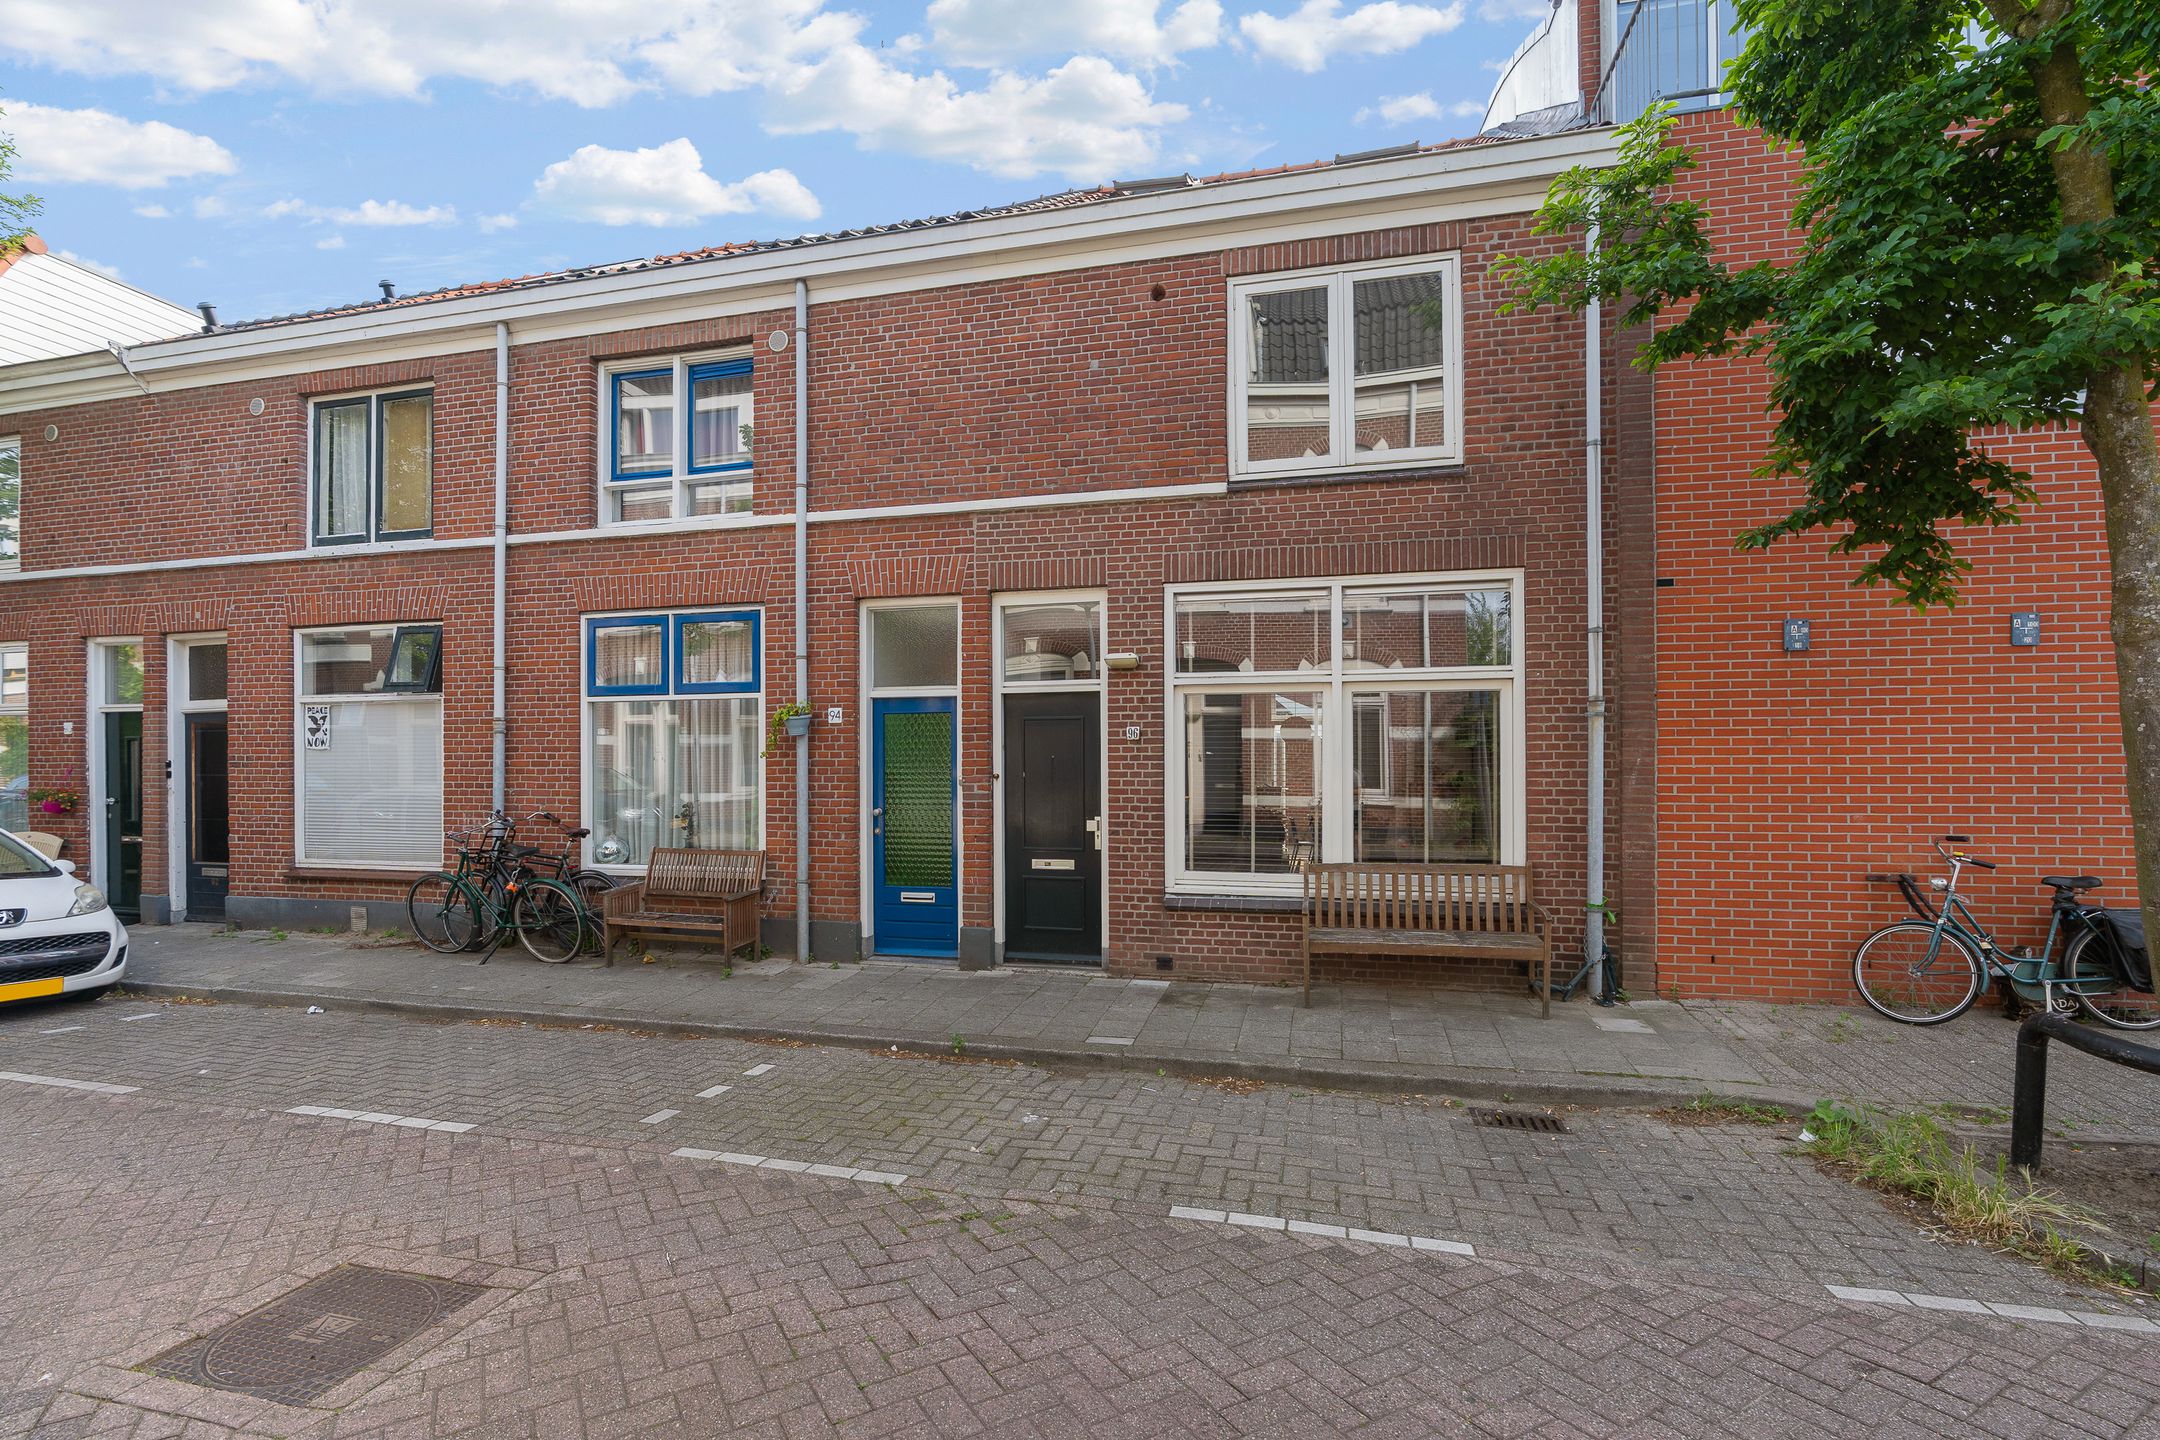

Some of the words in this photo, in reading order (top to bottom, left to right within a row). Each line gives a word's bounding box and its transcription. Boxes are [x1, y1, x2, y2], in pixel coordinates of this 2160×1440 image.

[2014, 619, 2020, 627] A
[1791, 625, 1797, 633] A
[307, 706, 328, 715] PEACE
[829, 710, 841, 721] 94
[1128, 727, 1138, 738] 96
[307, 737, 328, 748] NOW
